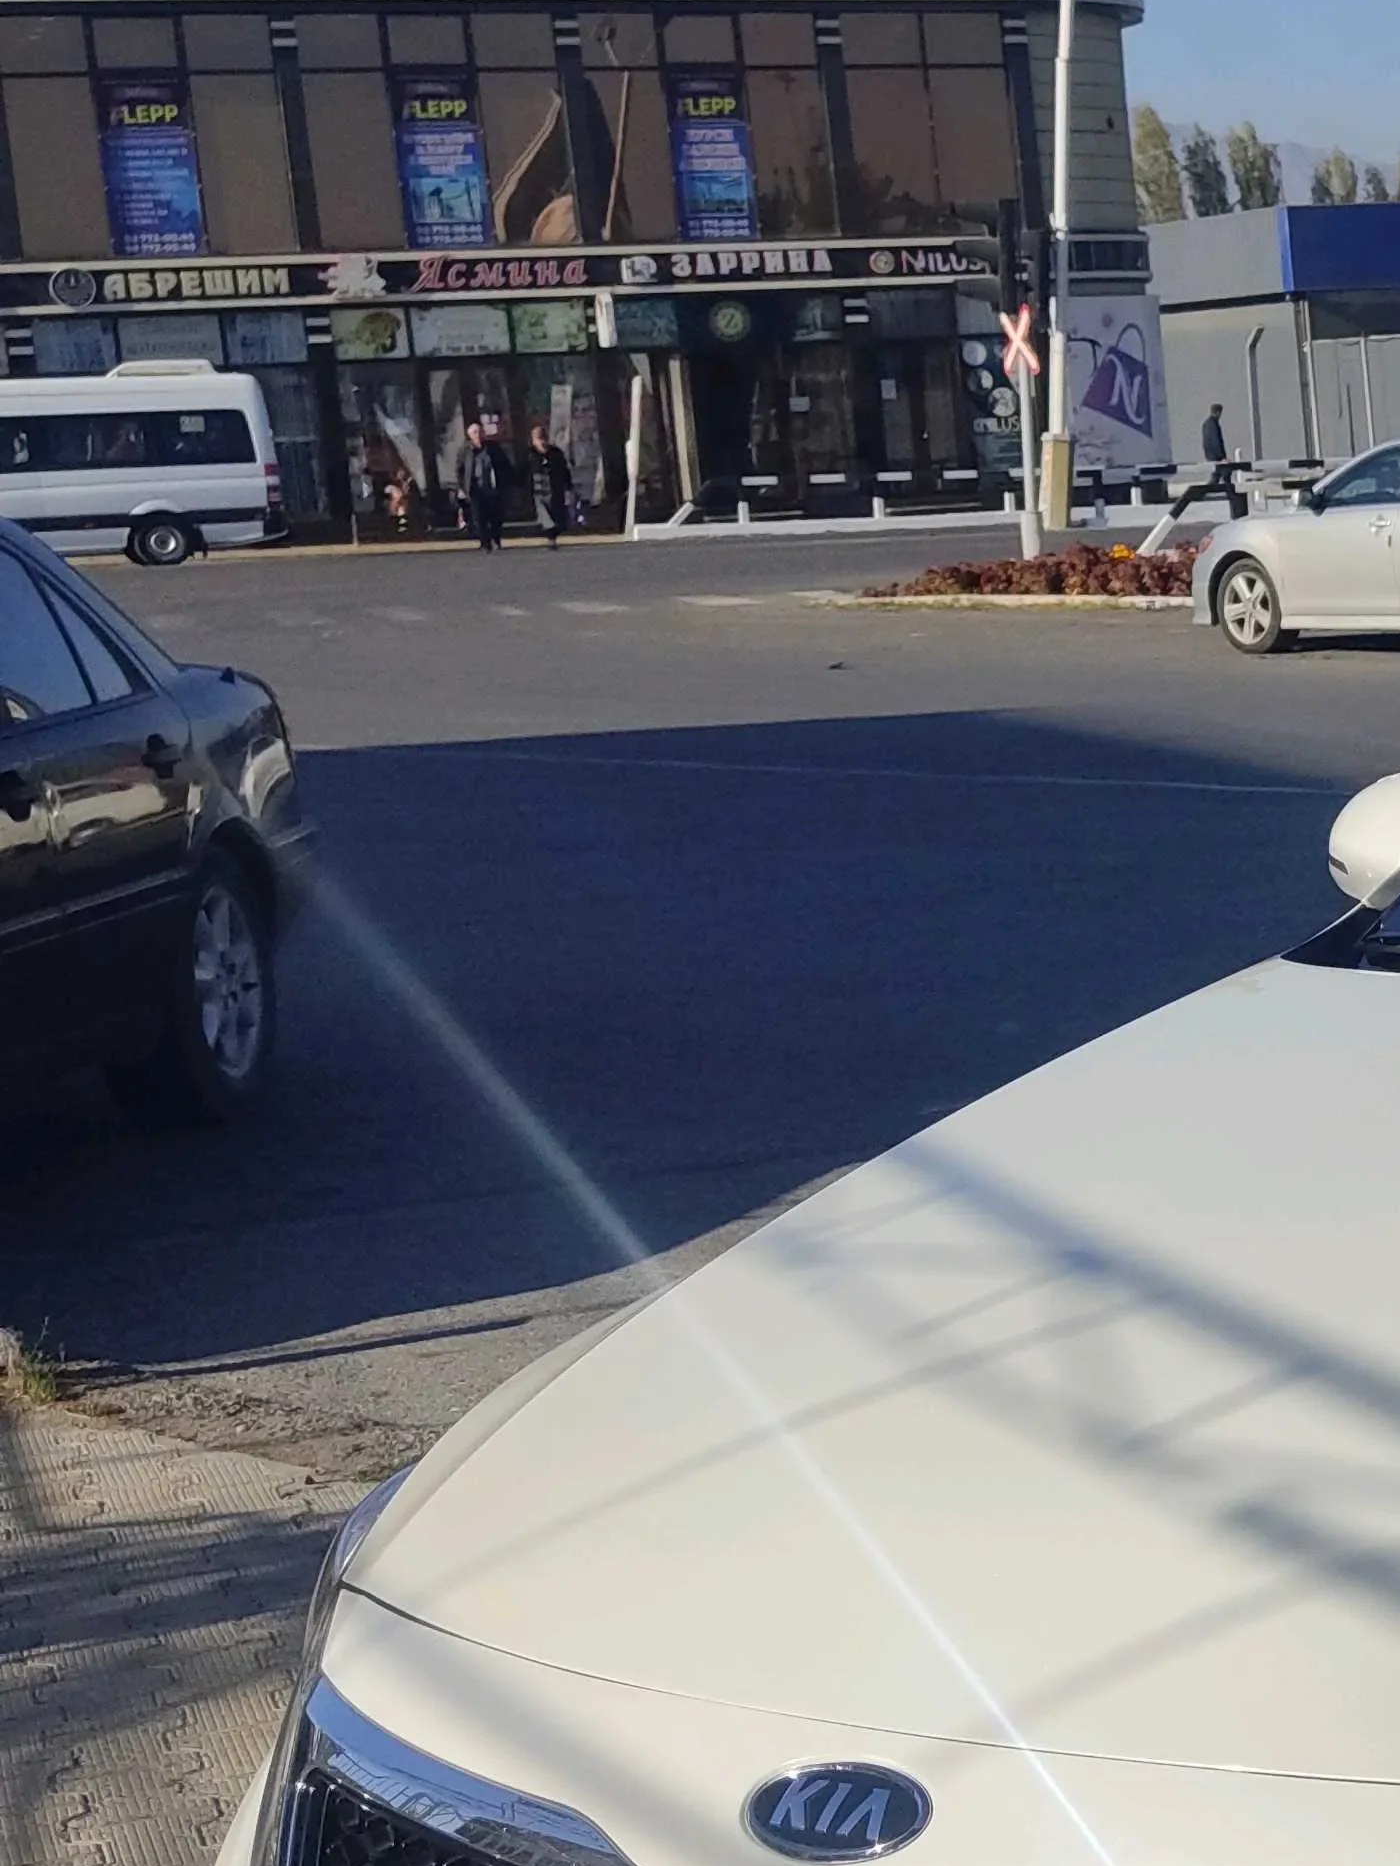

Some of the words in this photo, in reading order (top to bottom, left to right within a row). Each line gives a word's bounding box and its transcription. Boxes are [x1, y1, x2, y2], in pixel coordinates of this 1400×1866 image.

[103, 267, 291, 301] АБРЕШИМ
[409, 254, 589, 293] Ясмина
[769, 1776, 892, 1841] KIA
